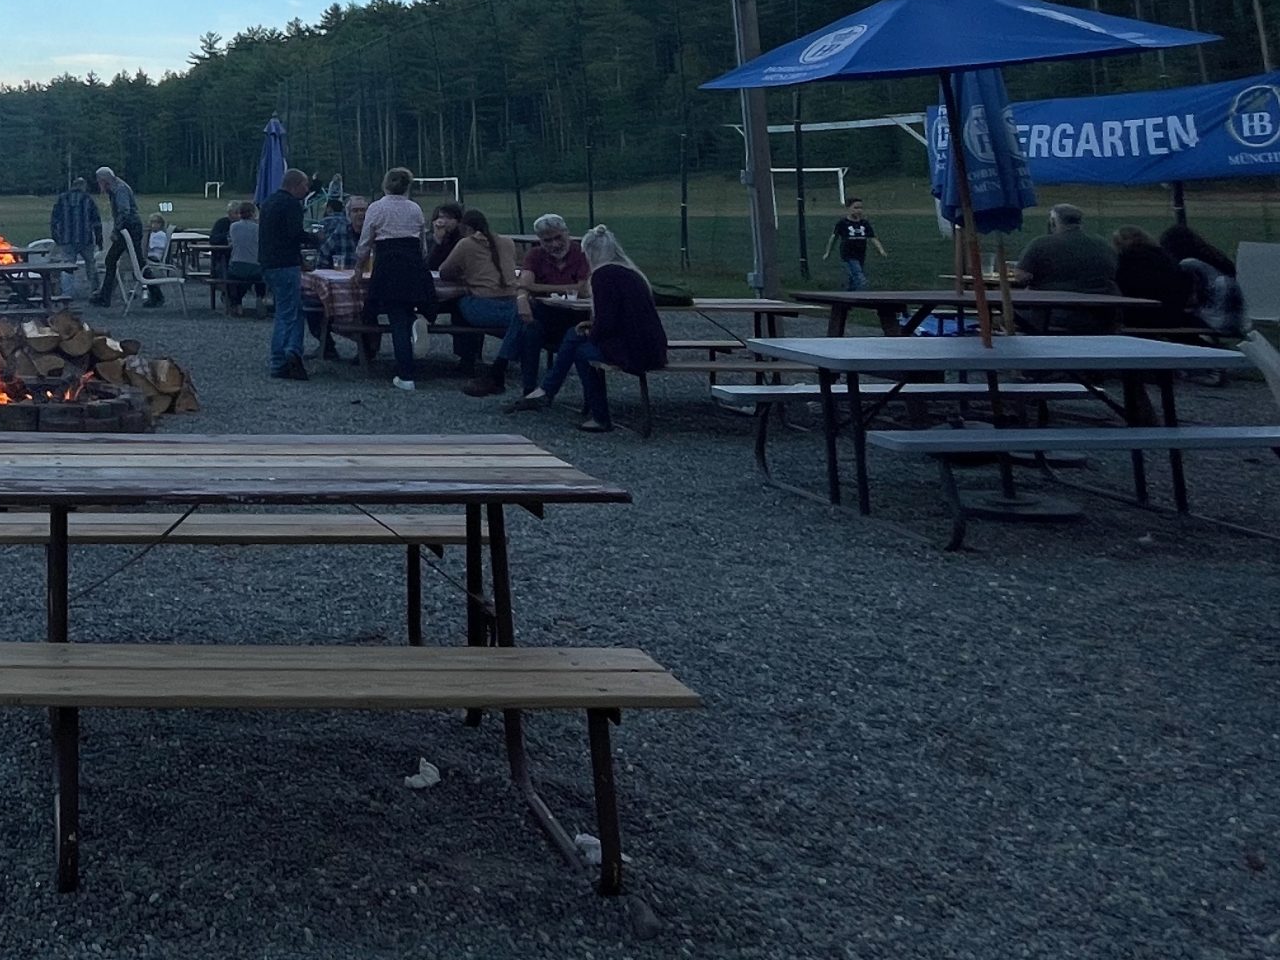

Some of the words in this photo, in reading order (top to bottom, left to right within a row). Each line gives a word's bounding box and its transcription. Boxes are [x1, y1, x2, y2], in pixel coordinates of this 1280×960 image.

[1015, 113, 1199, 159] ERGARTEN
[1241, 111, 1273, 138] HB
[1227, 151, 1280, 166] MÜNCH
